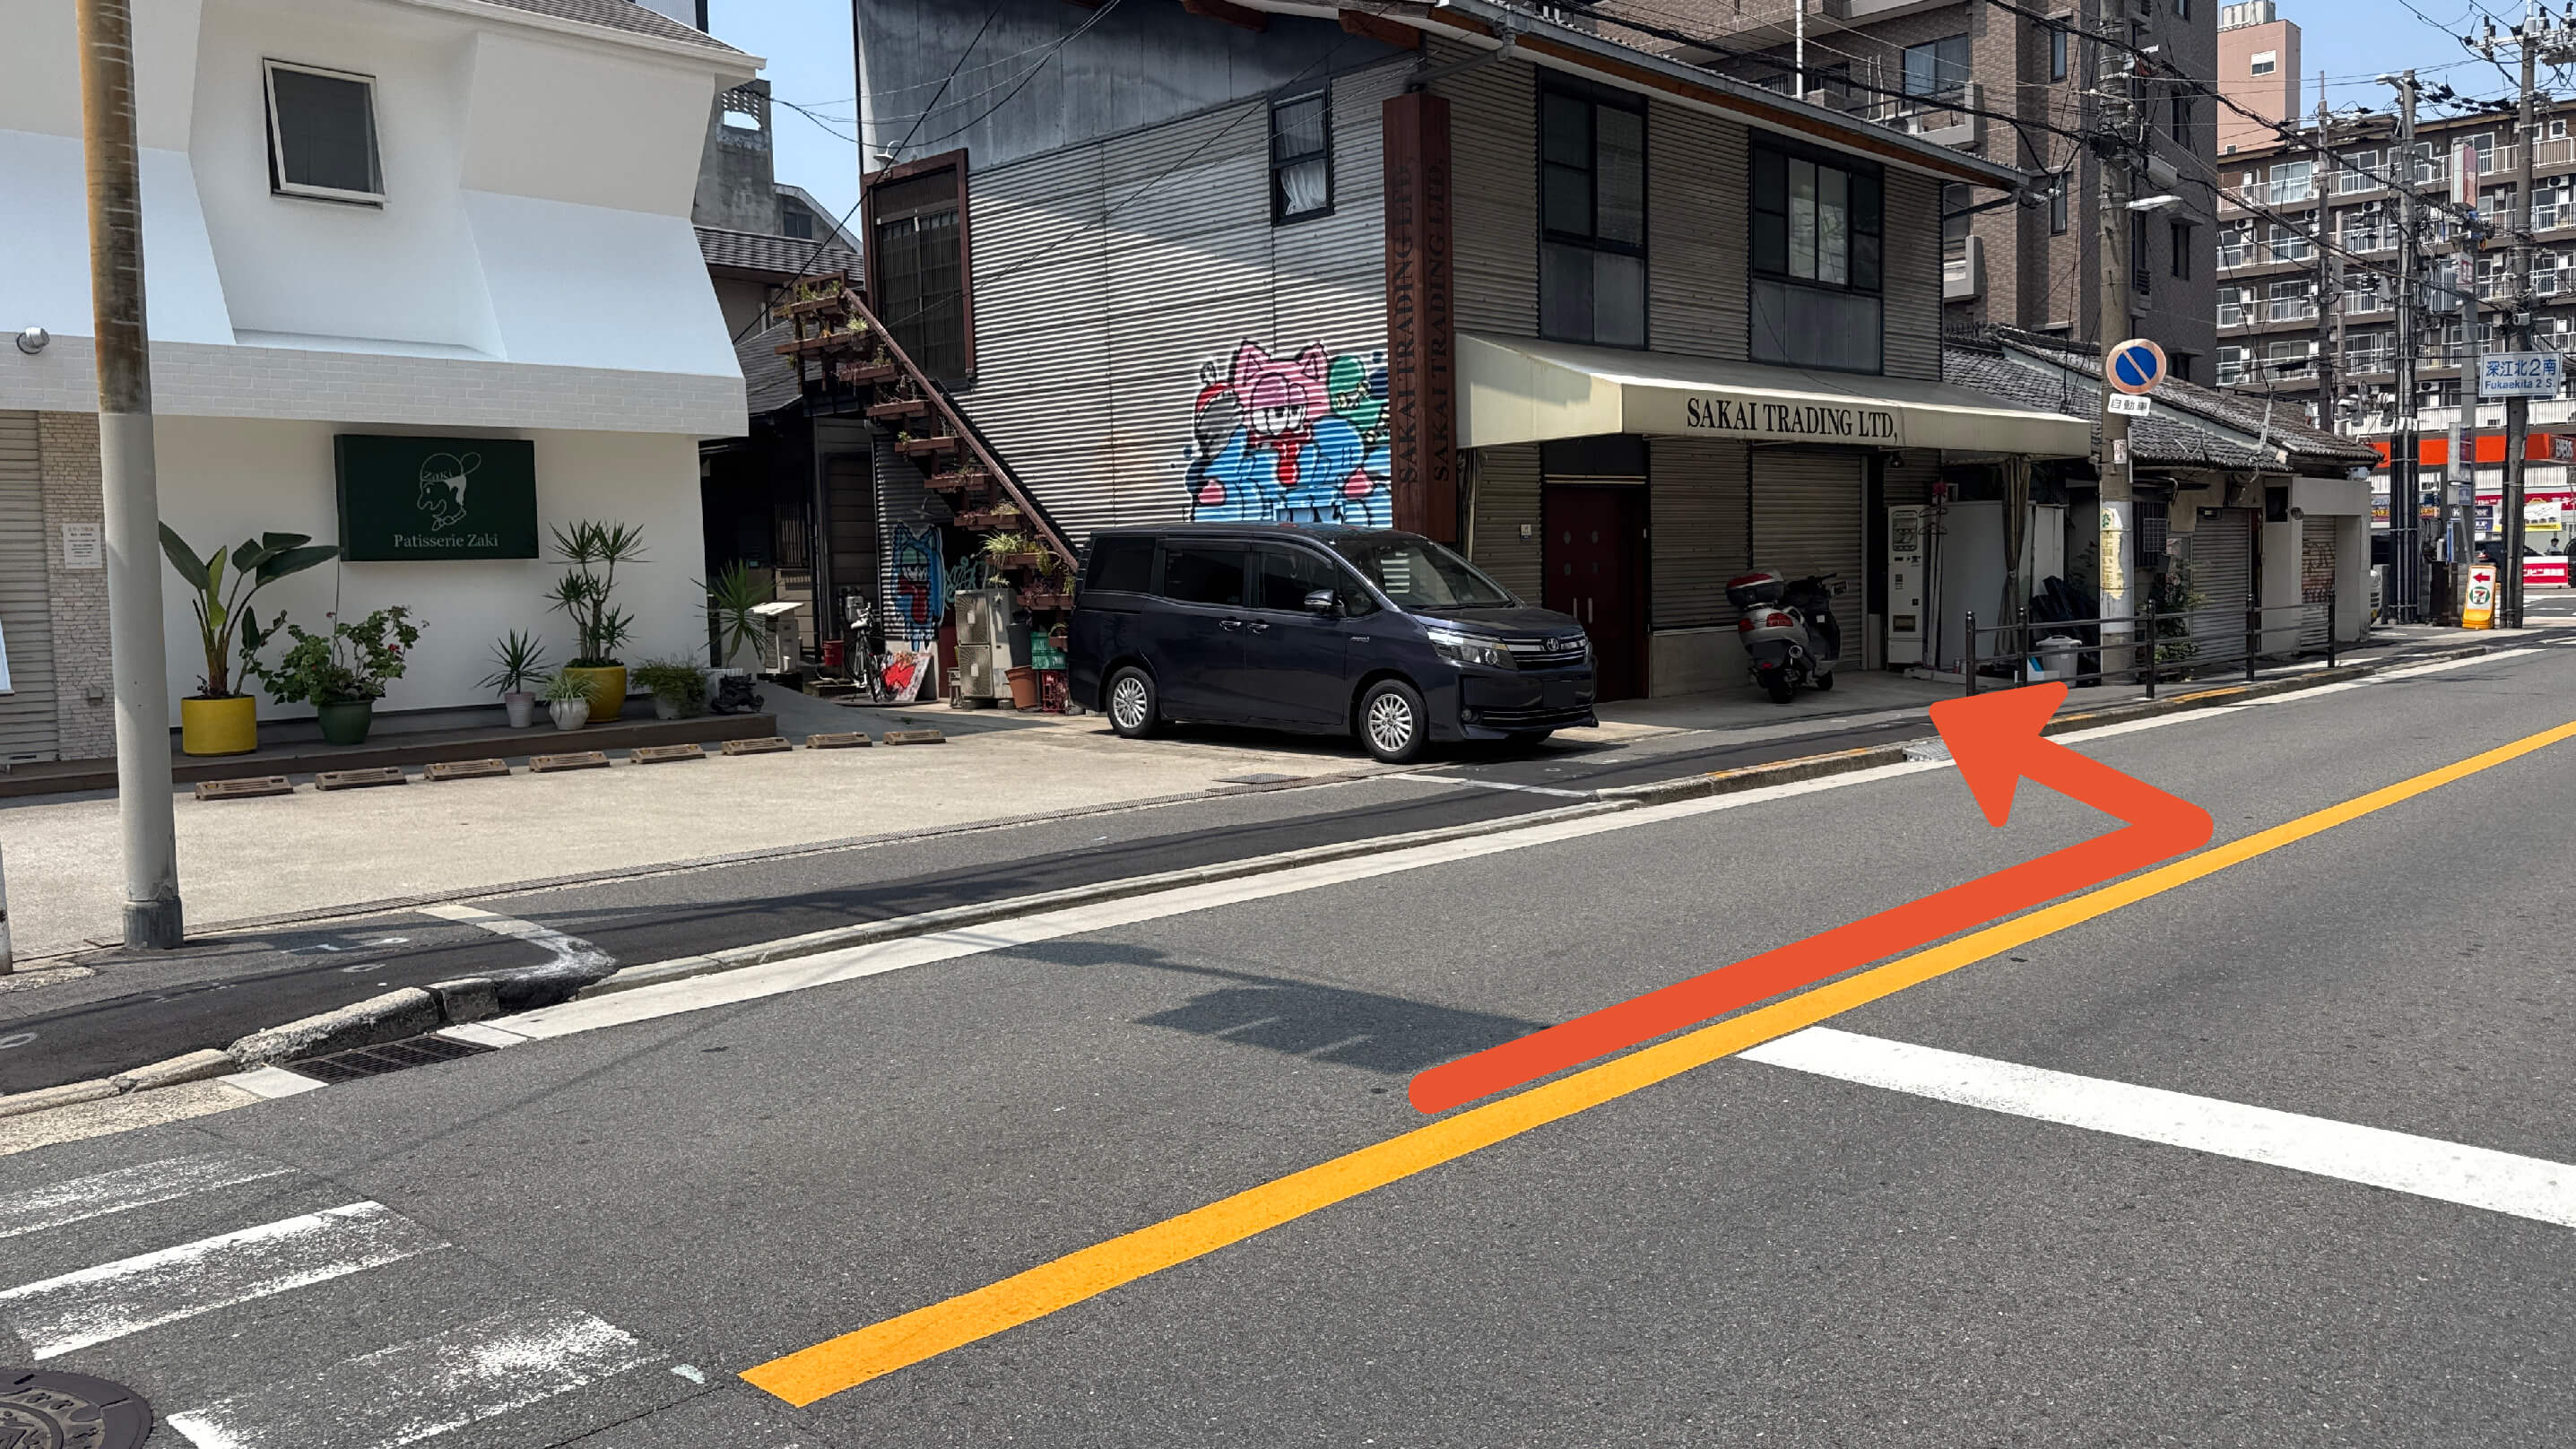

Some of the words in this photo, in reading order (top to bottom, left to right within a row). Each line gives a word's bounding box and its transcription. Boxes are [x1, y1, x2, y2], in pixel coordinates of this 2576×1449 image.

[1394, 237, 1414, 380] TRADING
[1428, 234, 1446, 379] TRADING
[1687, 397, 1757, 430] SAKAI
[1763, 403, 1853, 436] TRADING
[2111, 399, 2147, 411] 自動車
[2485, 379, 2533, 389] Fukaekita
[2536, 378, 2542, 388] 2
[1399, 389, 1418, 482] SAKAI
[1432, 387, 1450, 482] SAKAI
[394, 534, 464, 548] Patisserie
[467, 534, 499, 547] Zaki
